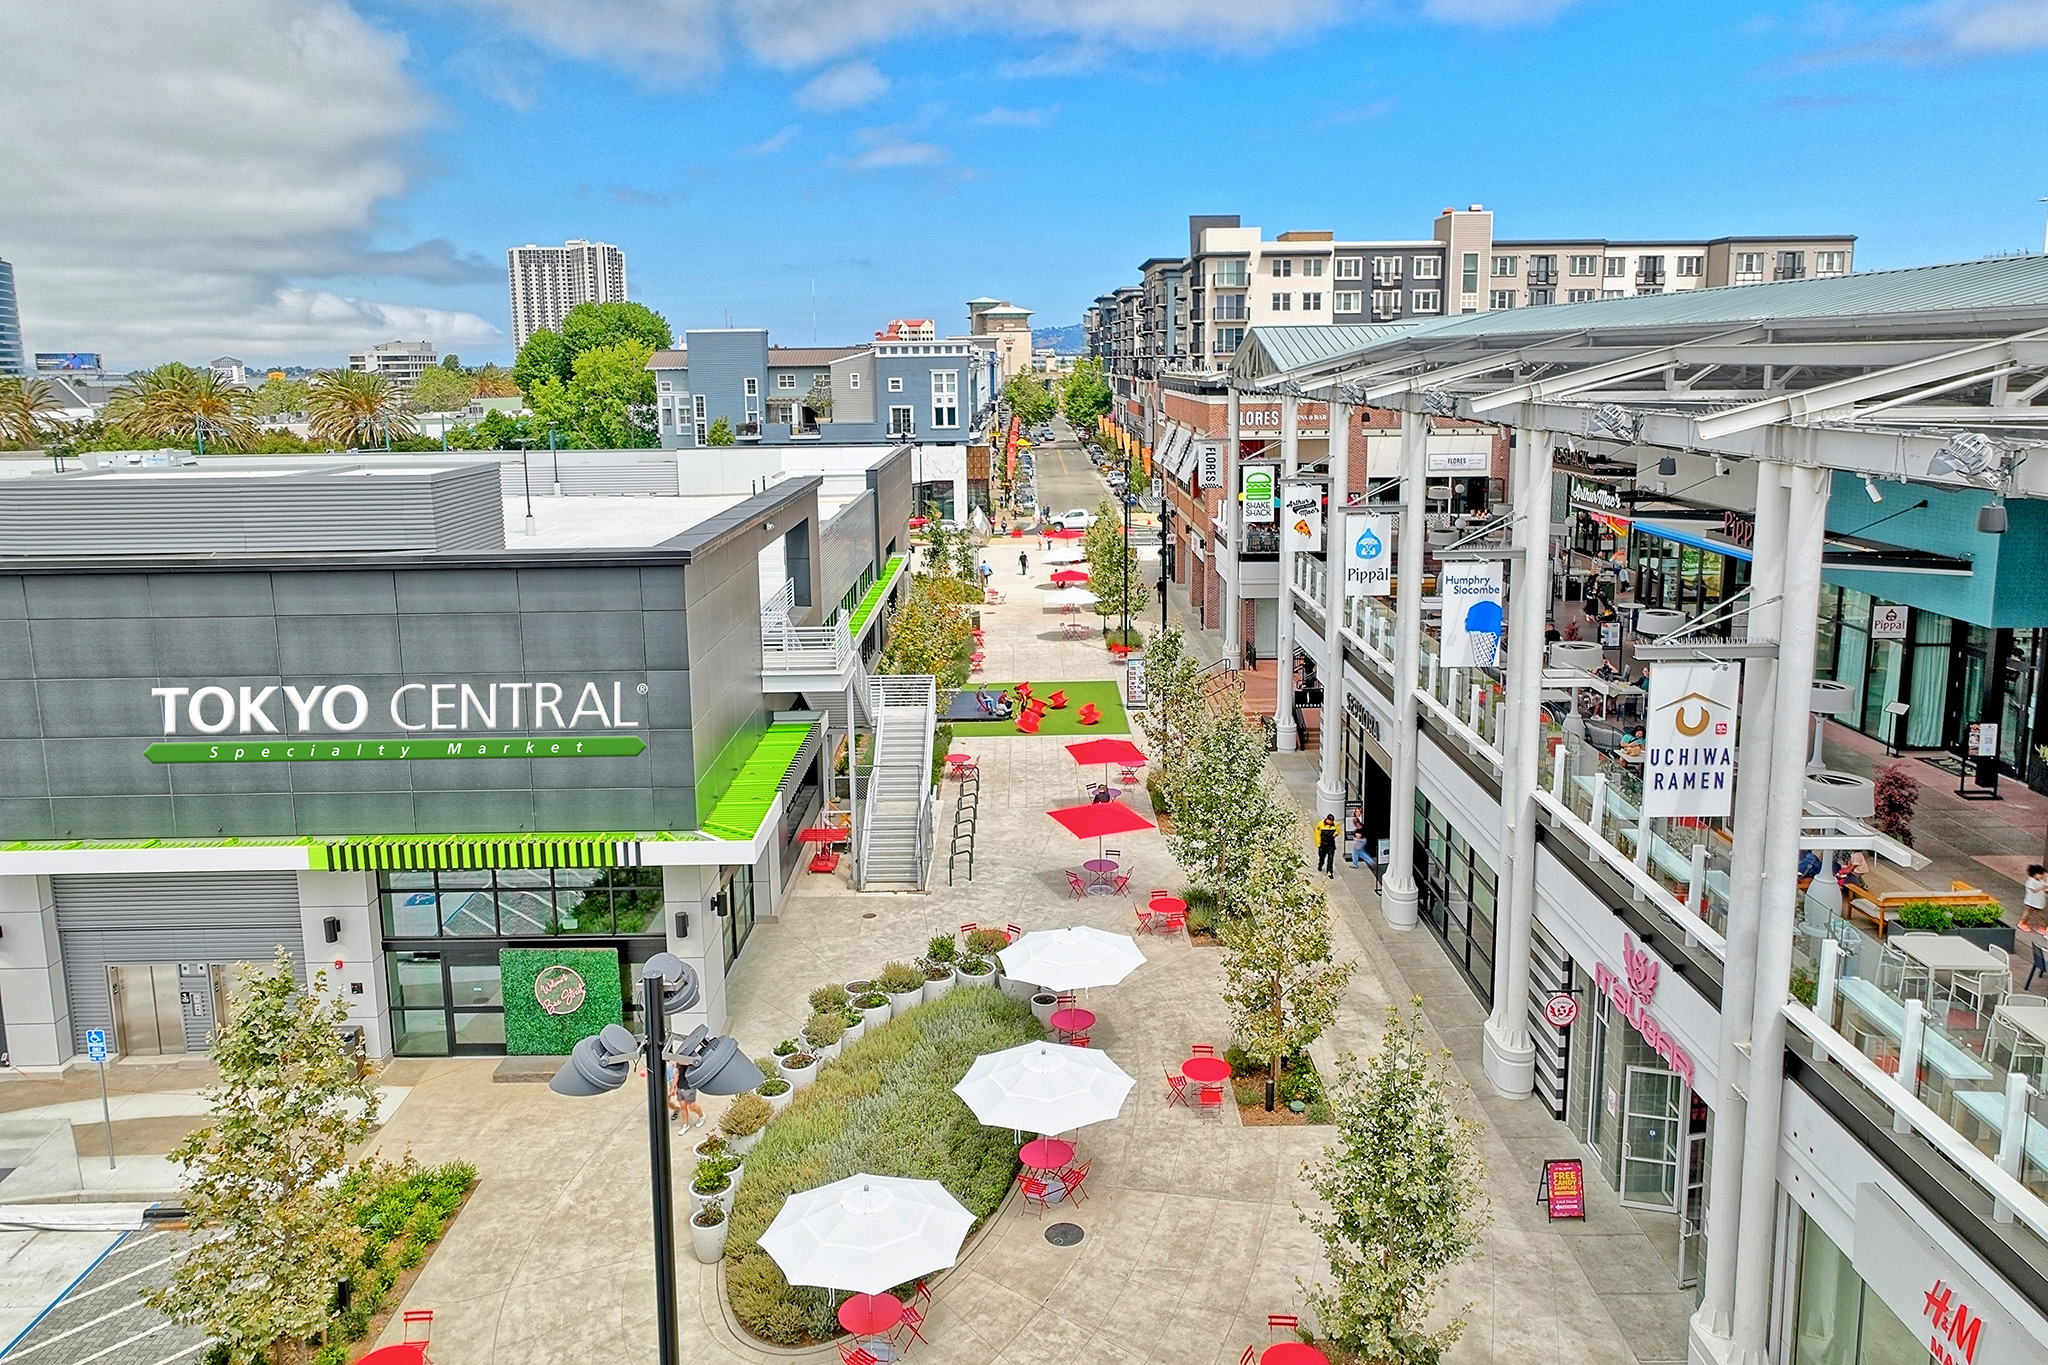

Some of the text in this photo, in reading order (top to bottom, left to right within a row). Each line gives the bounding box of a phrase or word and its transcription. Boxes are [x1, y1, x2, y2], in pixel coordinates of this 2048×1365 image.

[1239, 411, 1280, 426] LORES
[1205, 447, 1217, 482] FLORES
[1447, 457, 1467, 465] FLORES
[1245, 501, 1271, 509] SHAKE
[1245, 509, 1272, 517] SHACK
[1724, 511, 1753, 547] Pipp
[1347, 567, 1389, 584] Pippāl
[1445, 575, 1490, 587] Humphry
[1453, 585, 1500, 595] Slocombe
[151, 684, 370, 734] TOKYO
[1346, 692, 1380, 742] SEPHORA
[209, 740, 583, 760] Specialty Market
[1650, 748, 1731, 766] UCHIWA
[1654, 772, 1725, 790] RAMEN
[1553, 1171, 1576, 1180] FREE
[1922, 1279, 1982, 1365] H&M
